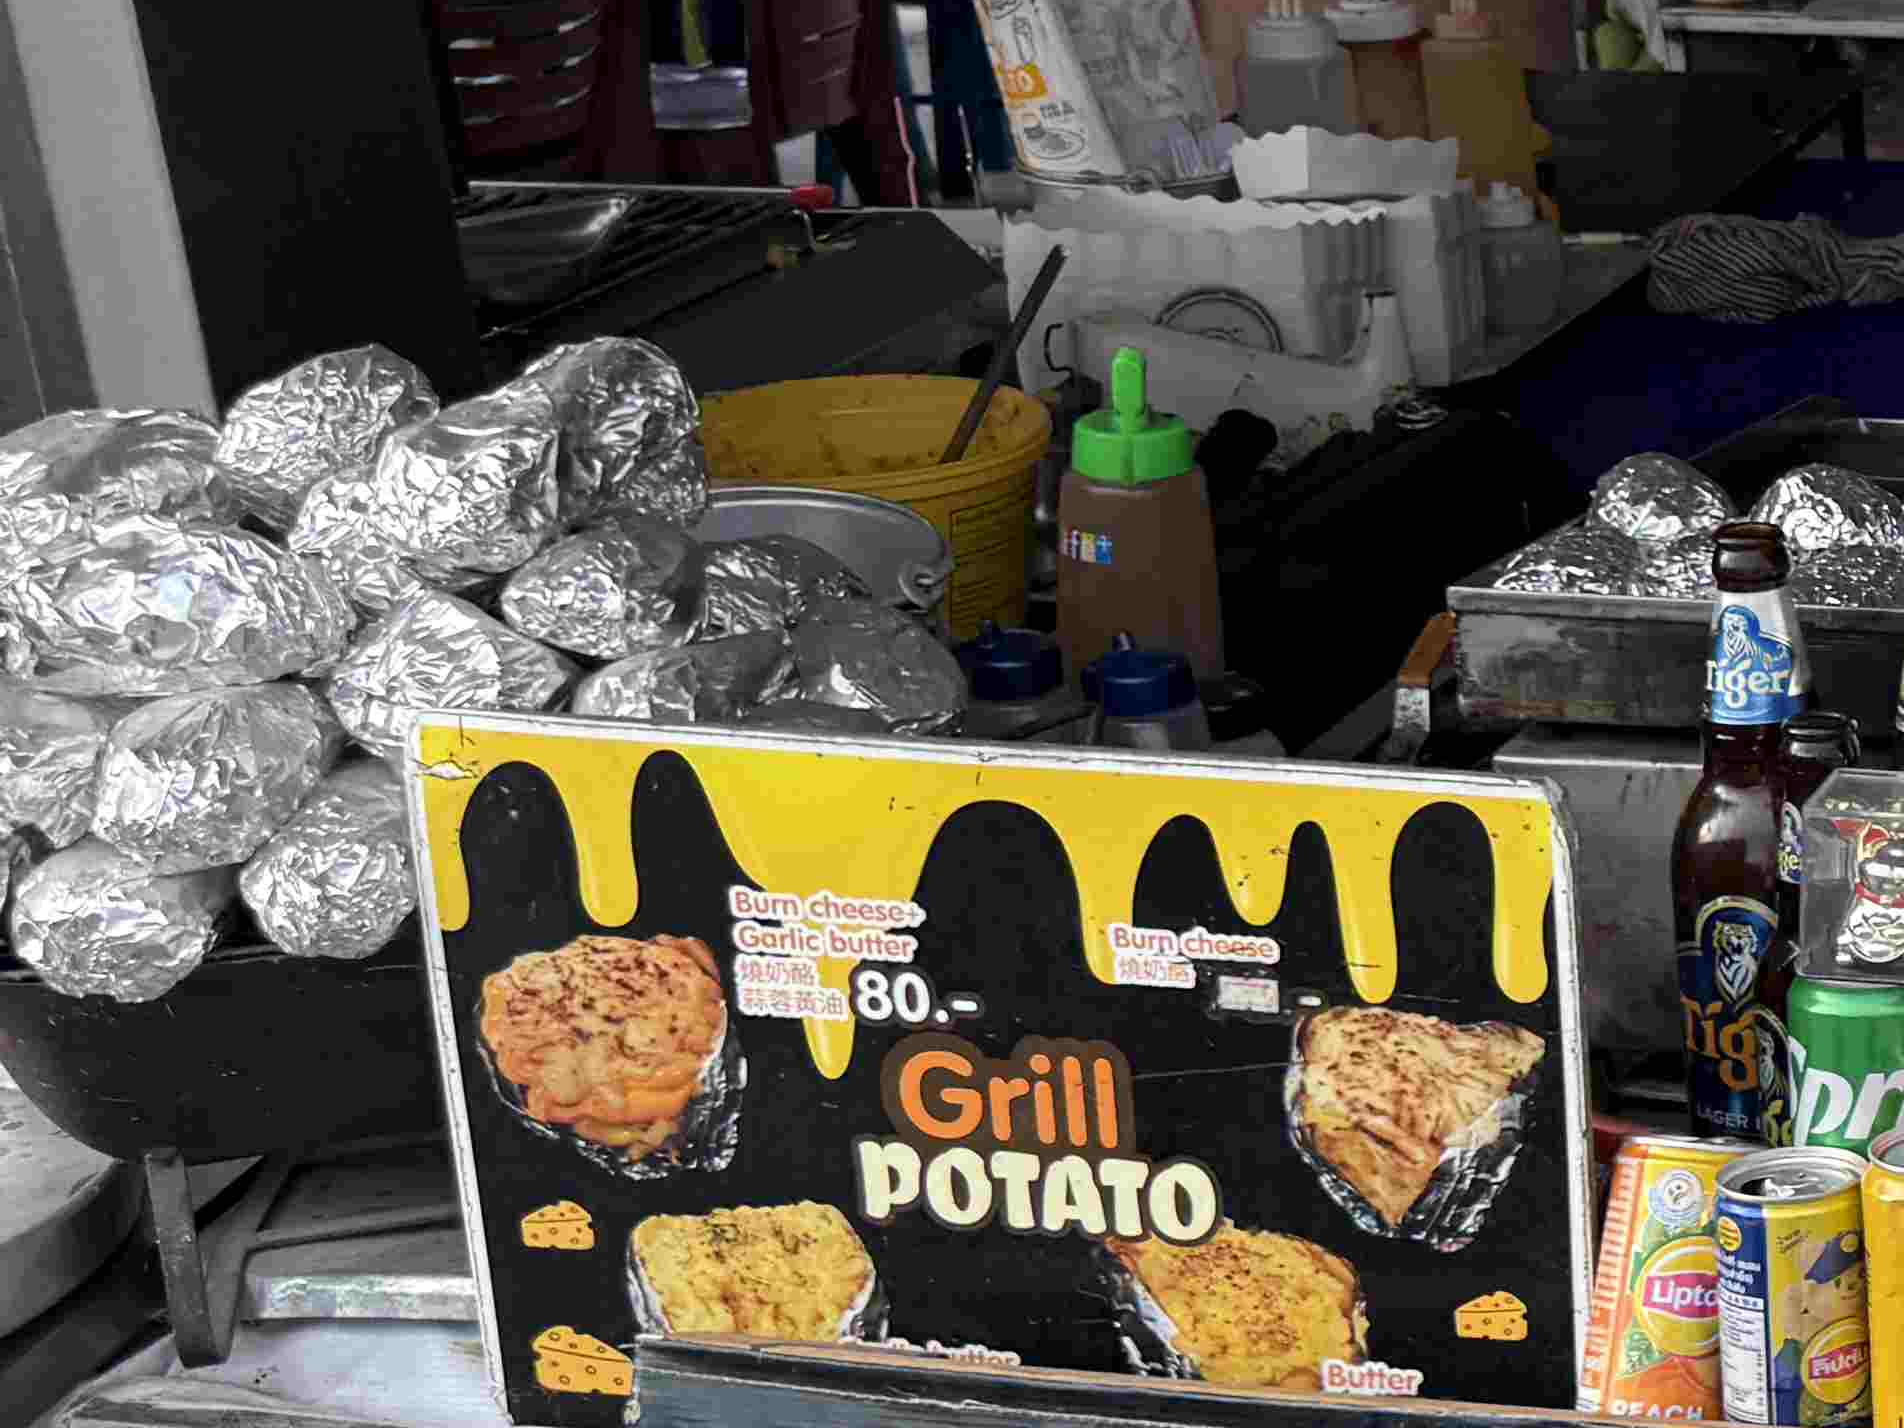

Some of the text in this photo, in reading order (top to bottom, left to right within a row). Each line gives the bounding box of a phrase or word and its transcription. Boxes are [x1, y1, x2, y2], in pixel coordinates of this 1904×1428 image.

[1705, 658, 1793, 709] Tiger
[734, 890, 800, 916] Burn
[738, 925, 914, 958] Garlic butter
[1114, 927, 1274, 961] Burn cheese
[858, 970, 979, 1024] 80.-
[900, 1050, 1118, 1149] Grill
[858, 1140, 1217, 1241] POTATO
[1326, 1362, 1419, 1391] Butter
